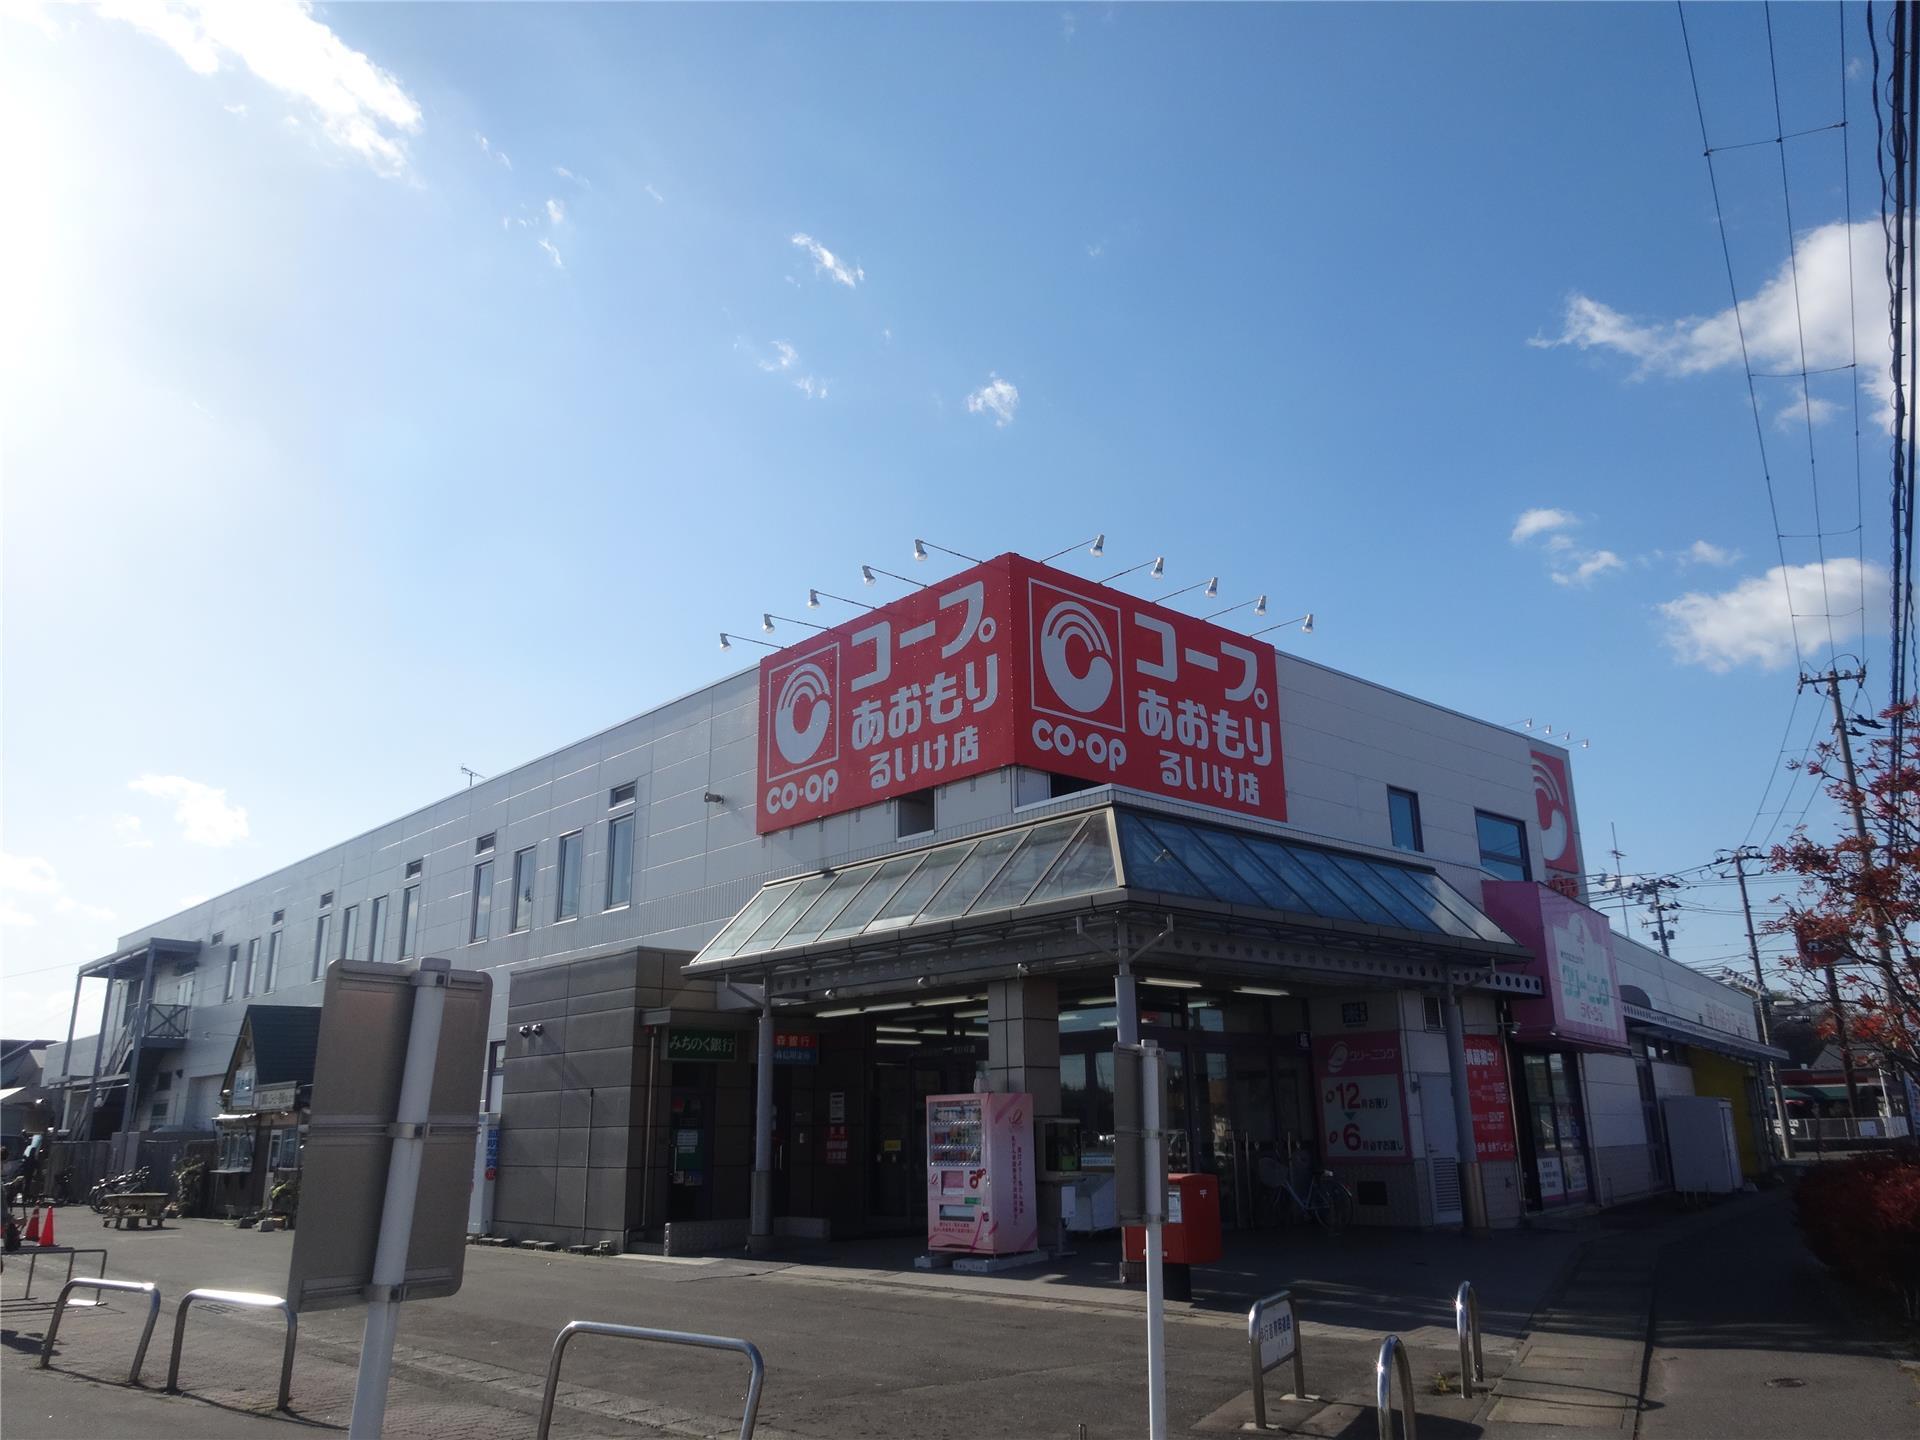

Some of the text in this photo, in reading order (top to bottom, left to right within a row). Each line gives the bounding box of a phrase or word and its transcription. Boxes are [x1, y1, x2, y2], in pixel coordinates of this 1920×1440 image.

[851, 653, 999, 750] あおもり
[1138, 688, 1272, 767] あおもり
[869, 725, 979, 790] るいけ店
[1160, 749, 1260, 806] るいけ店
[669, 1035, 736, 1053] みちのく銀行
[775, 1033, 811, 1048] 森銀行
